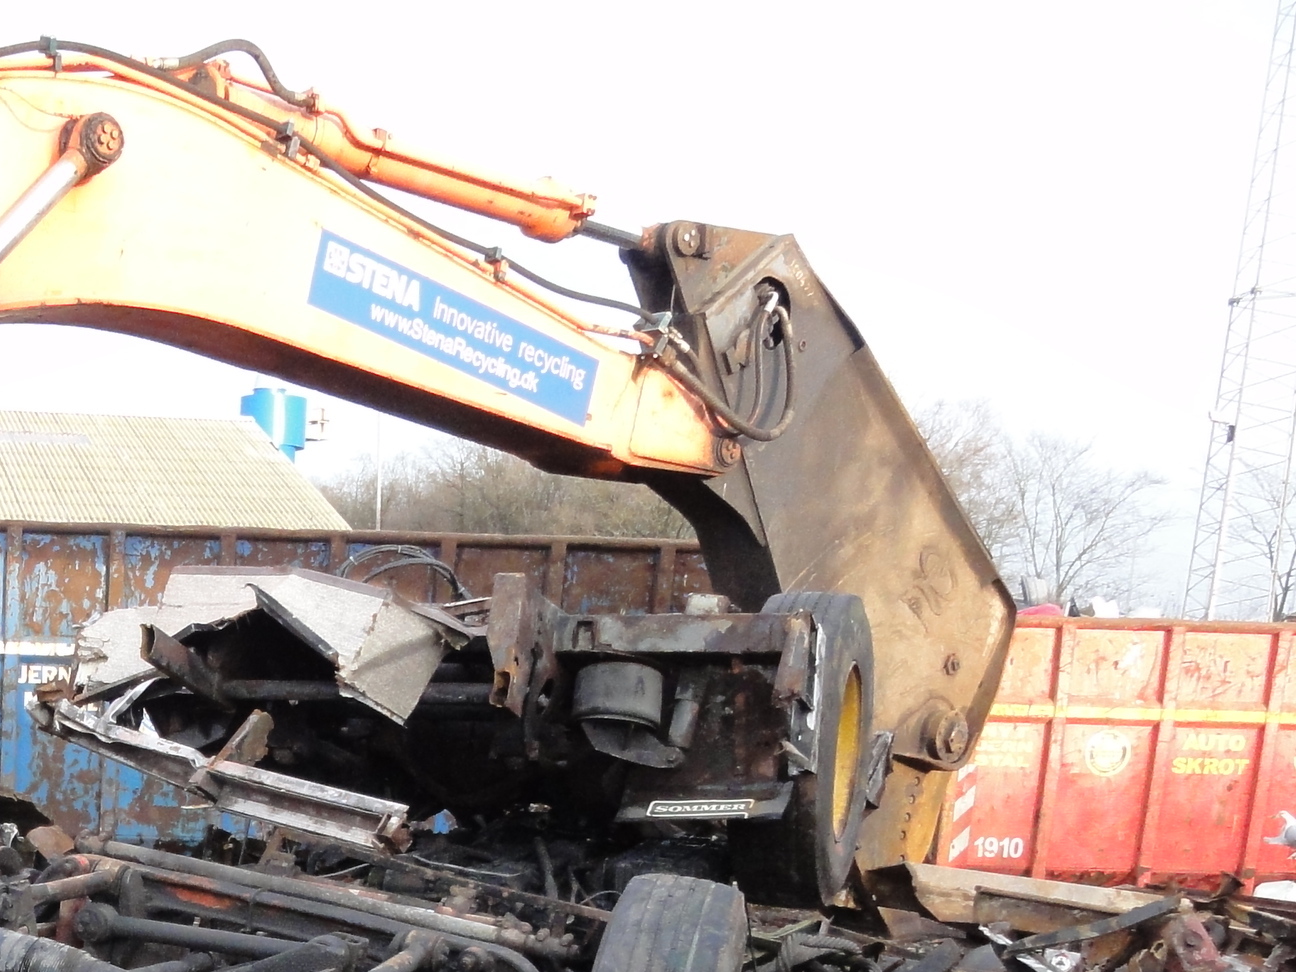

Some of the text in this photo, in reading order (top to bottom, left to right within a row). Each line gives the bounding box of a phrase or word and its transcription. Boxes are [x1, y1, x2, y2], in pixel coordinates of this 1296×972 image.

[345, 252, 587, 391] STENA Innovative recycling
[371, 303, 540, 393] www.StenaRecycling.dk
[17, 665, 72, 685] JERN
[975, 740, 1033, 753] JERN
[1183, 734, 1245, 751] AUTO
[1171, 757, 1250, 775] SKROT
[654, 804, 746, 813] SOMMER
[974, 836, 1024, 859] 1910
